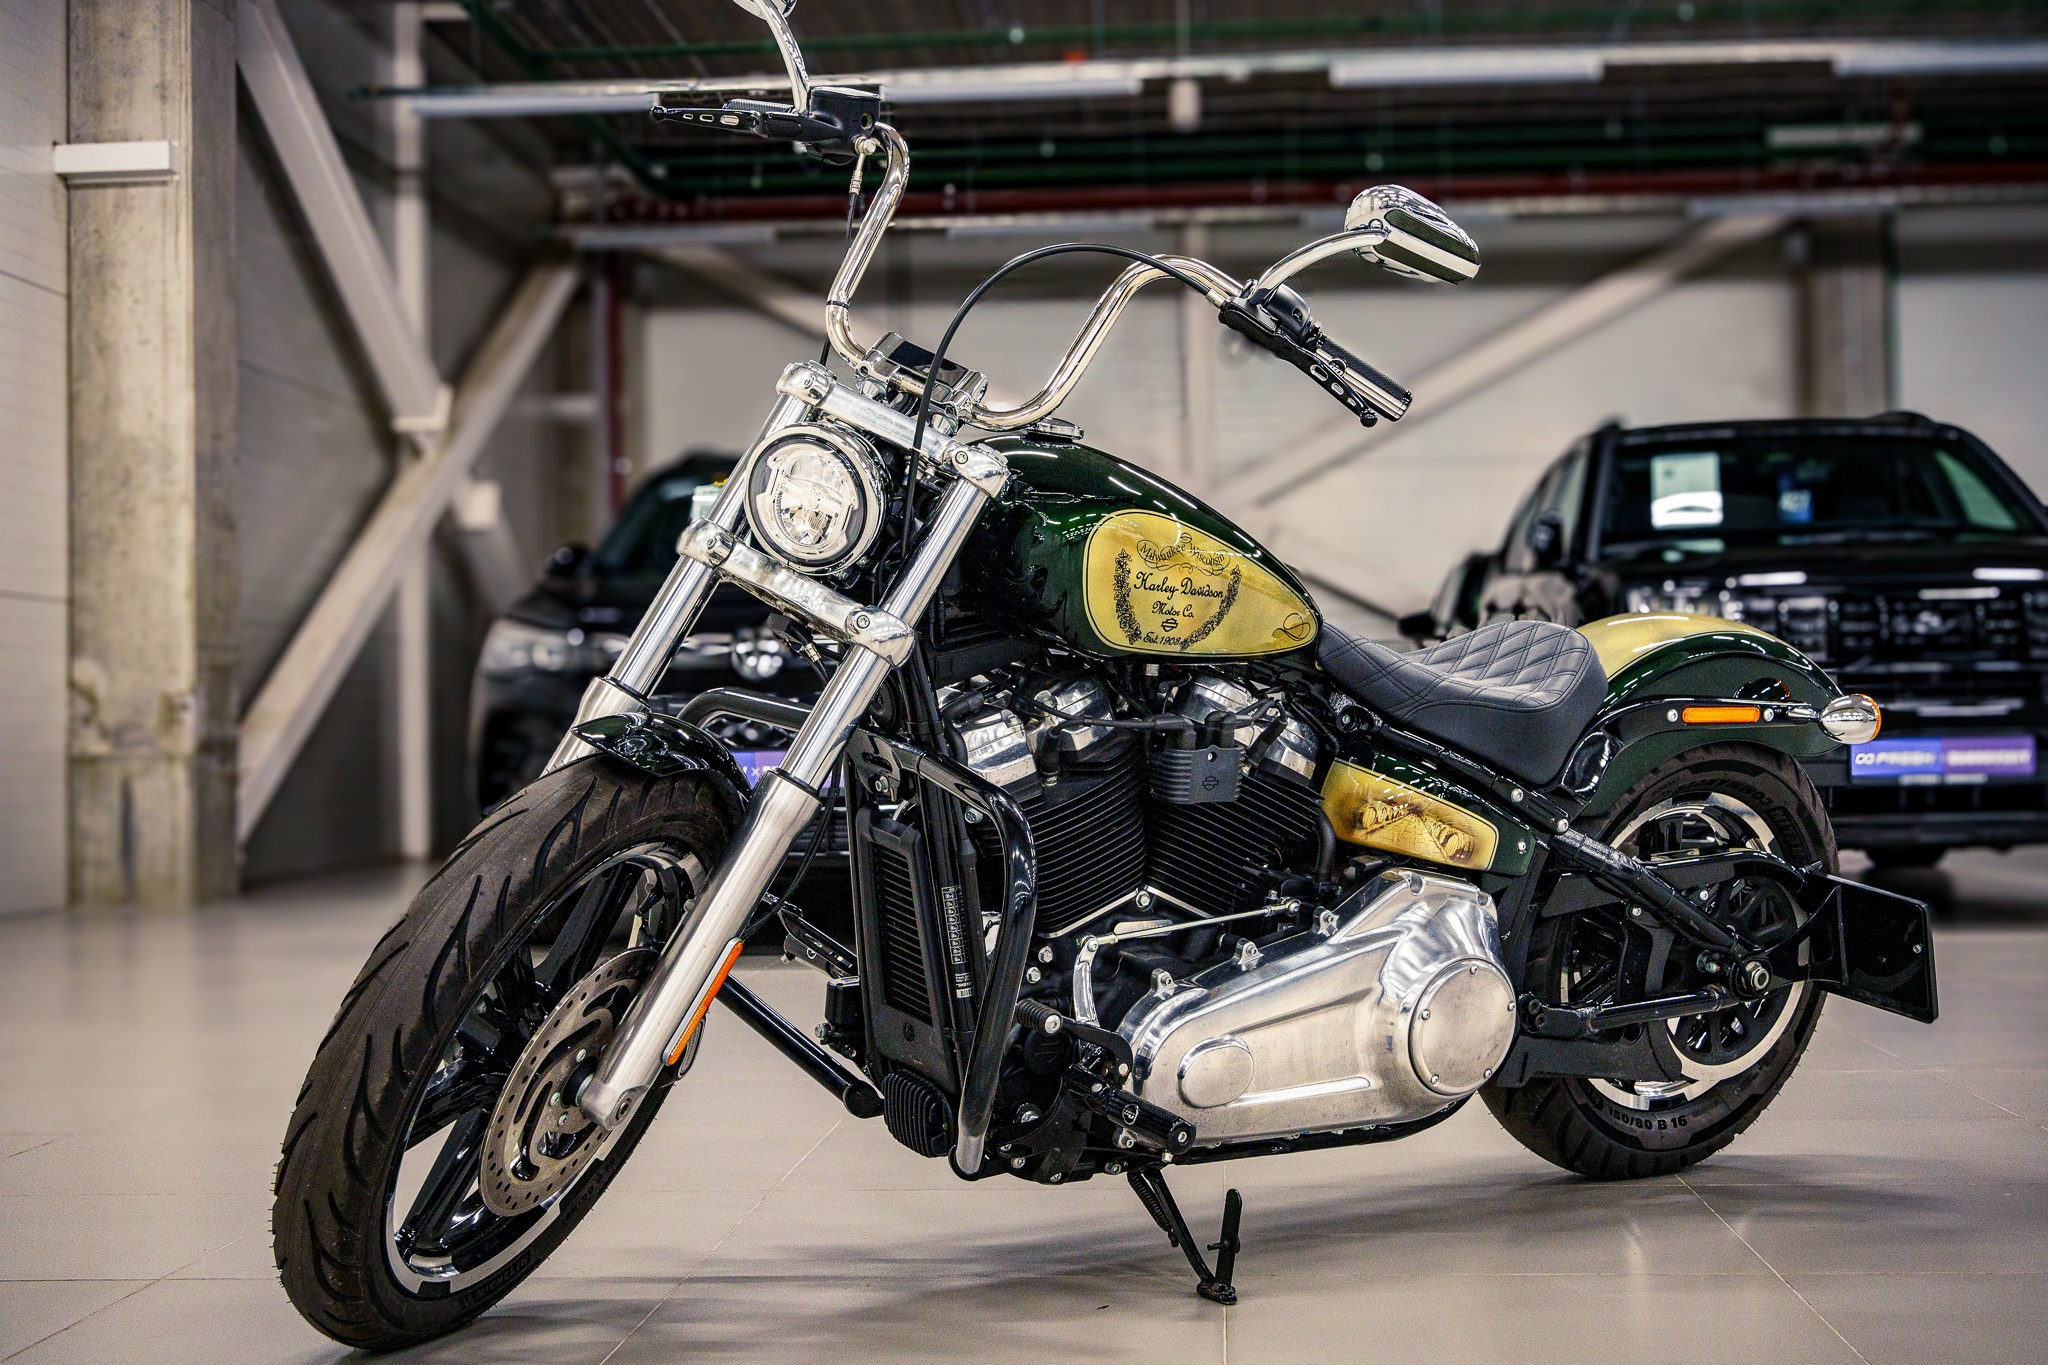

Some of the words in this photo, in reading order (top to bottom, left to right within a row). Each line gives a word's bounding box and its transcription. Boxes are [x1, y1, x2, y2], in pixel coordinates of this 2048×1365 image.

[1138, 541, 1186, 562] Milwaukee
[1133, 571, 1224, 600] Harley-Davidson
[1152, 600, 1180, 616] Motor
[1182, 603, 1195, 618] Co.
[1143, 631, 1158, 645] Est.
[1607, 1105, 1653, 1130] 150/80
[1657, 1119, 1668, 1130] B
[1670, 1115, 1688, 1129] 16
[475, 1248, 532, 1298] MICHELIN
